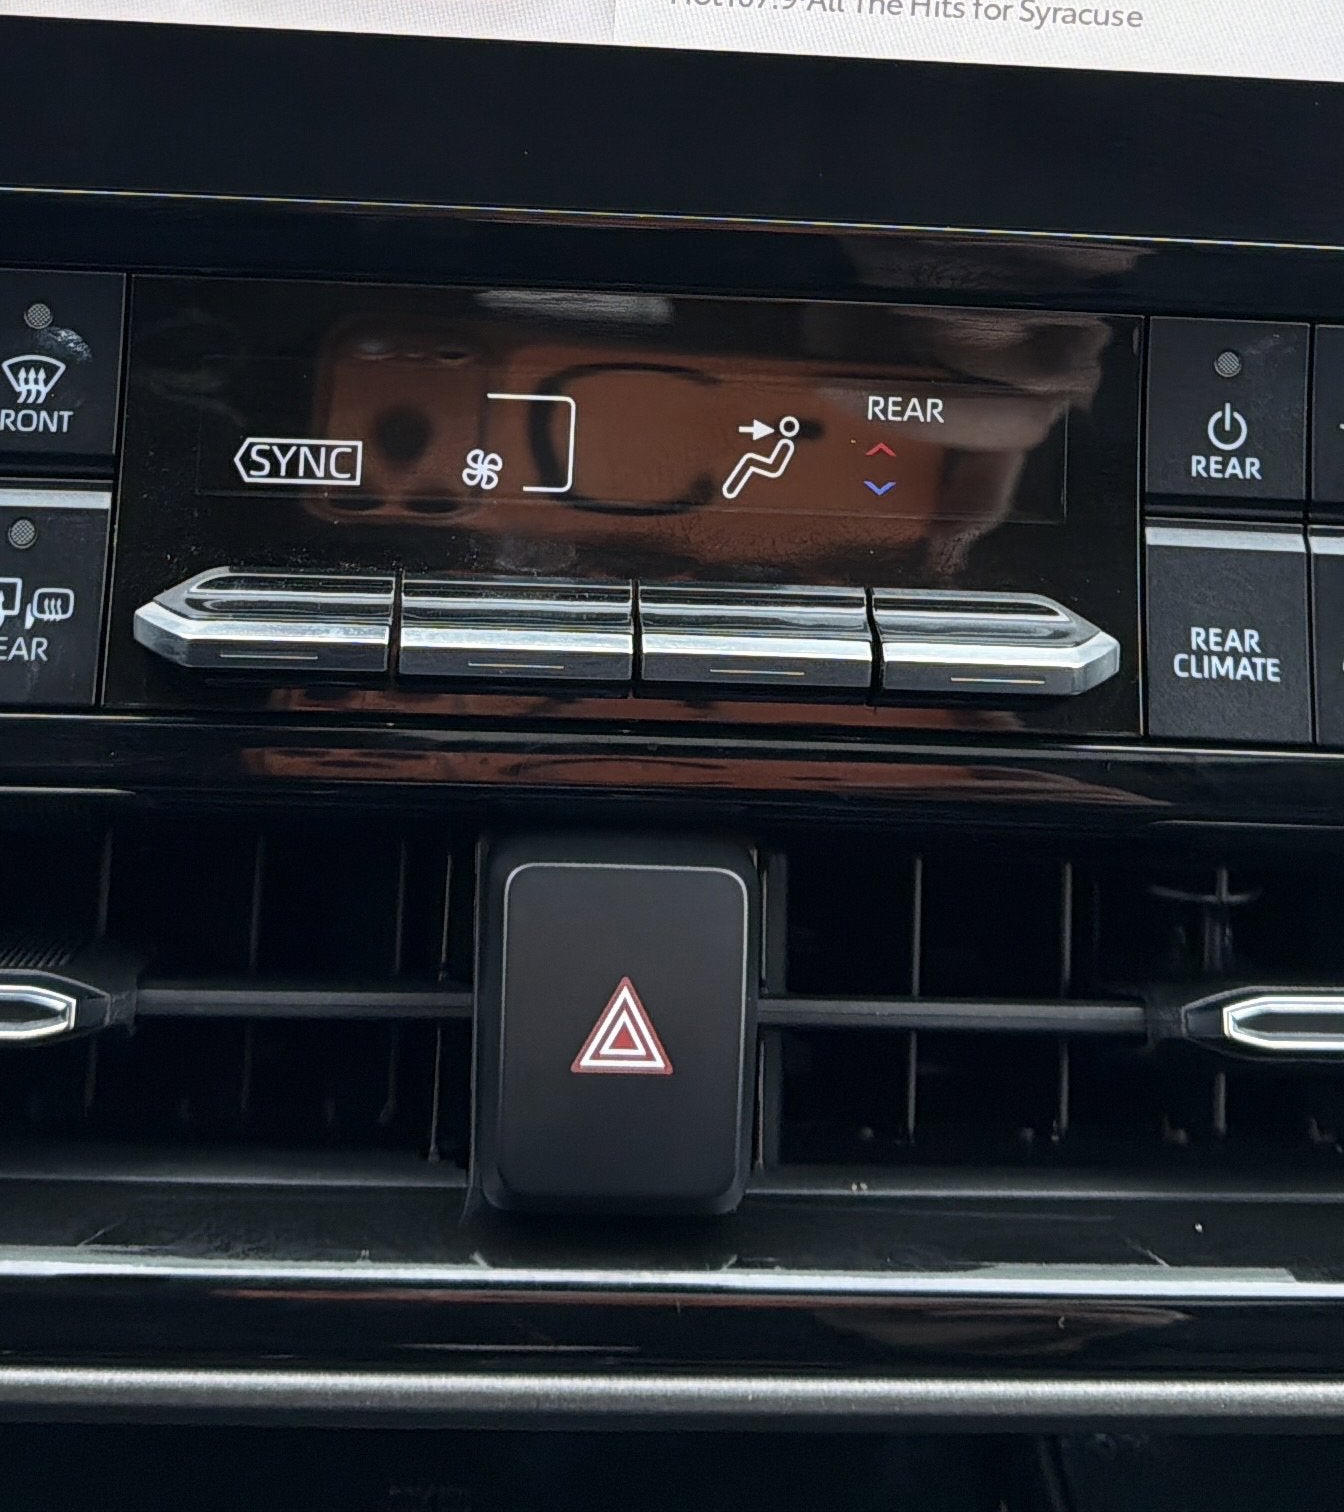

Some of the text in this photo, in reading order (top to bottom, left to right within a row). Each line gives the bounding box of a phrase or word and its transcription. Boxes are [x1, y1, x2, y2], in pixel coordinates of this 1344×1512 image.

[866, 394, 947, 425] REAR
[249, 443, 354, 480] SYNC
[1190, 453, 1263, 481] REAR
[1189, 625, 1262, 655] REAR
[1172, 652, 1282, 683] CLIMATE
